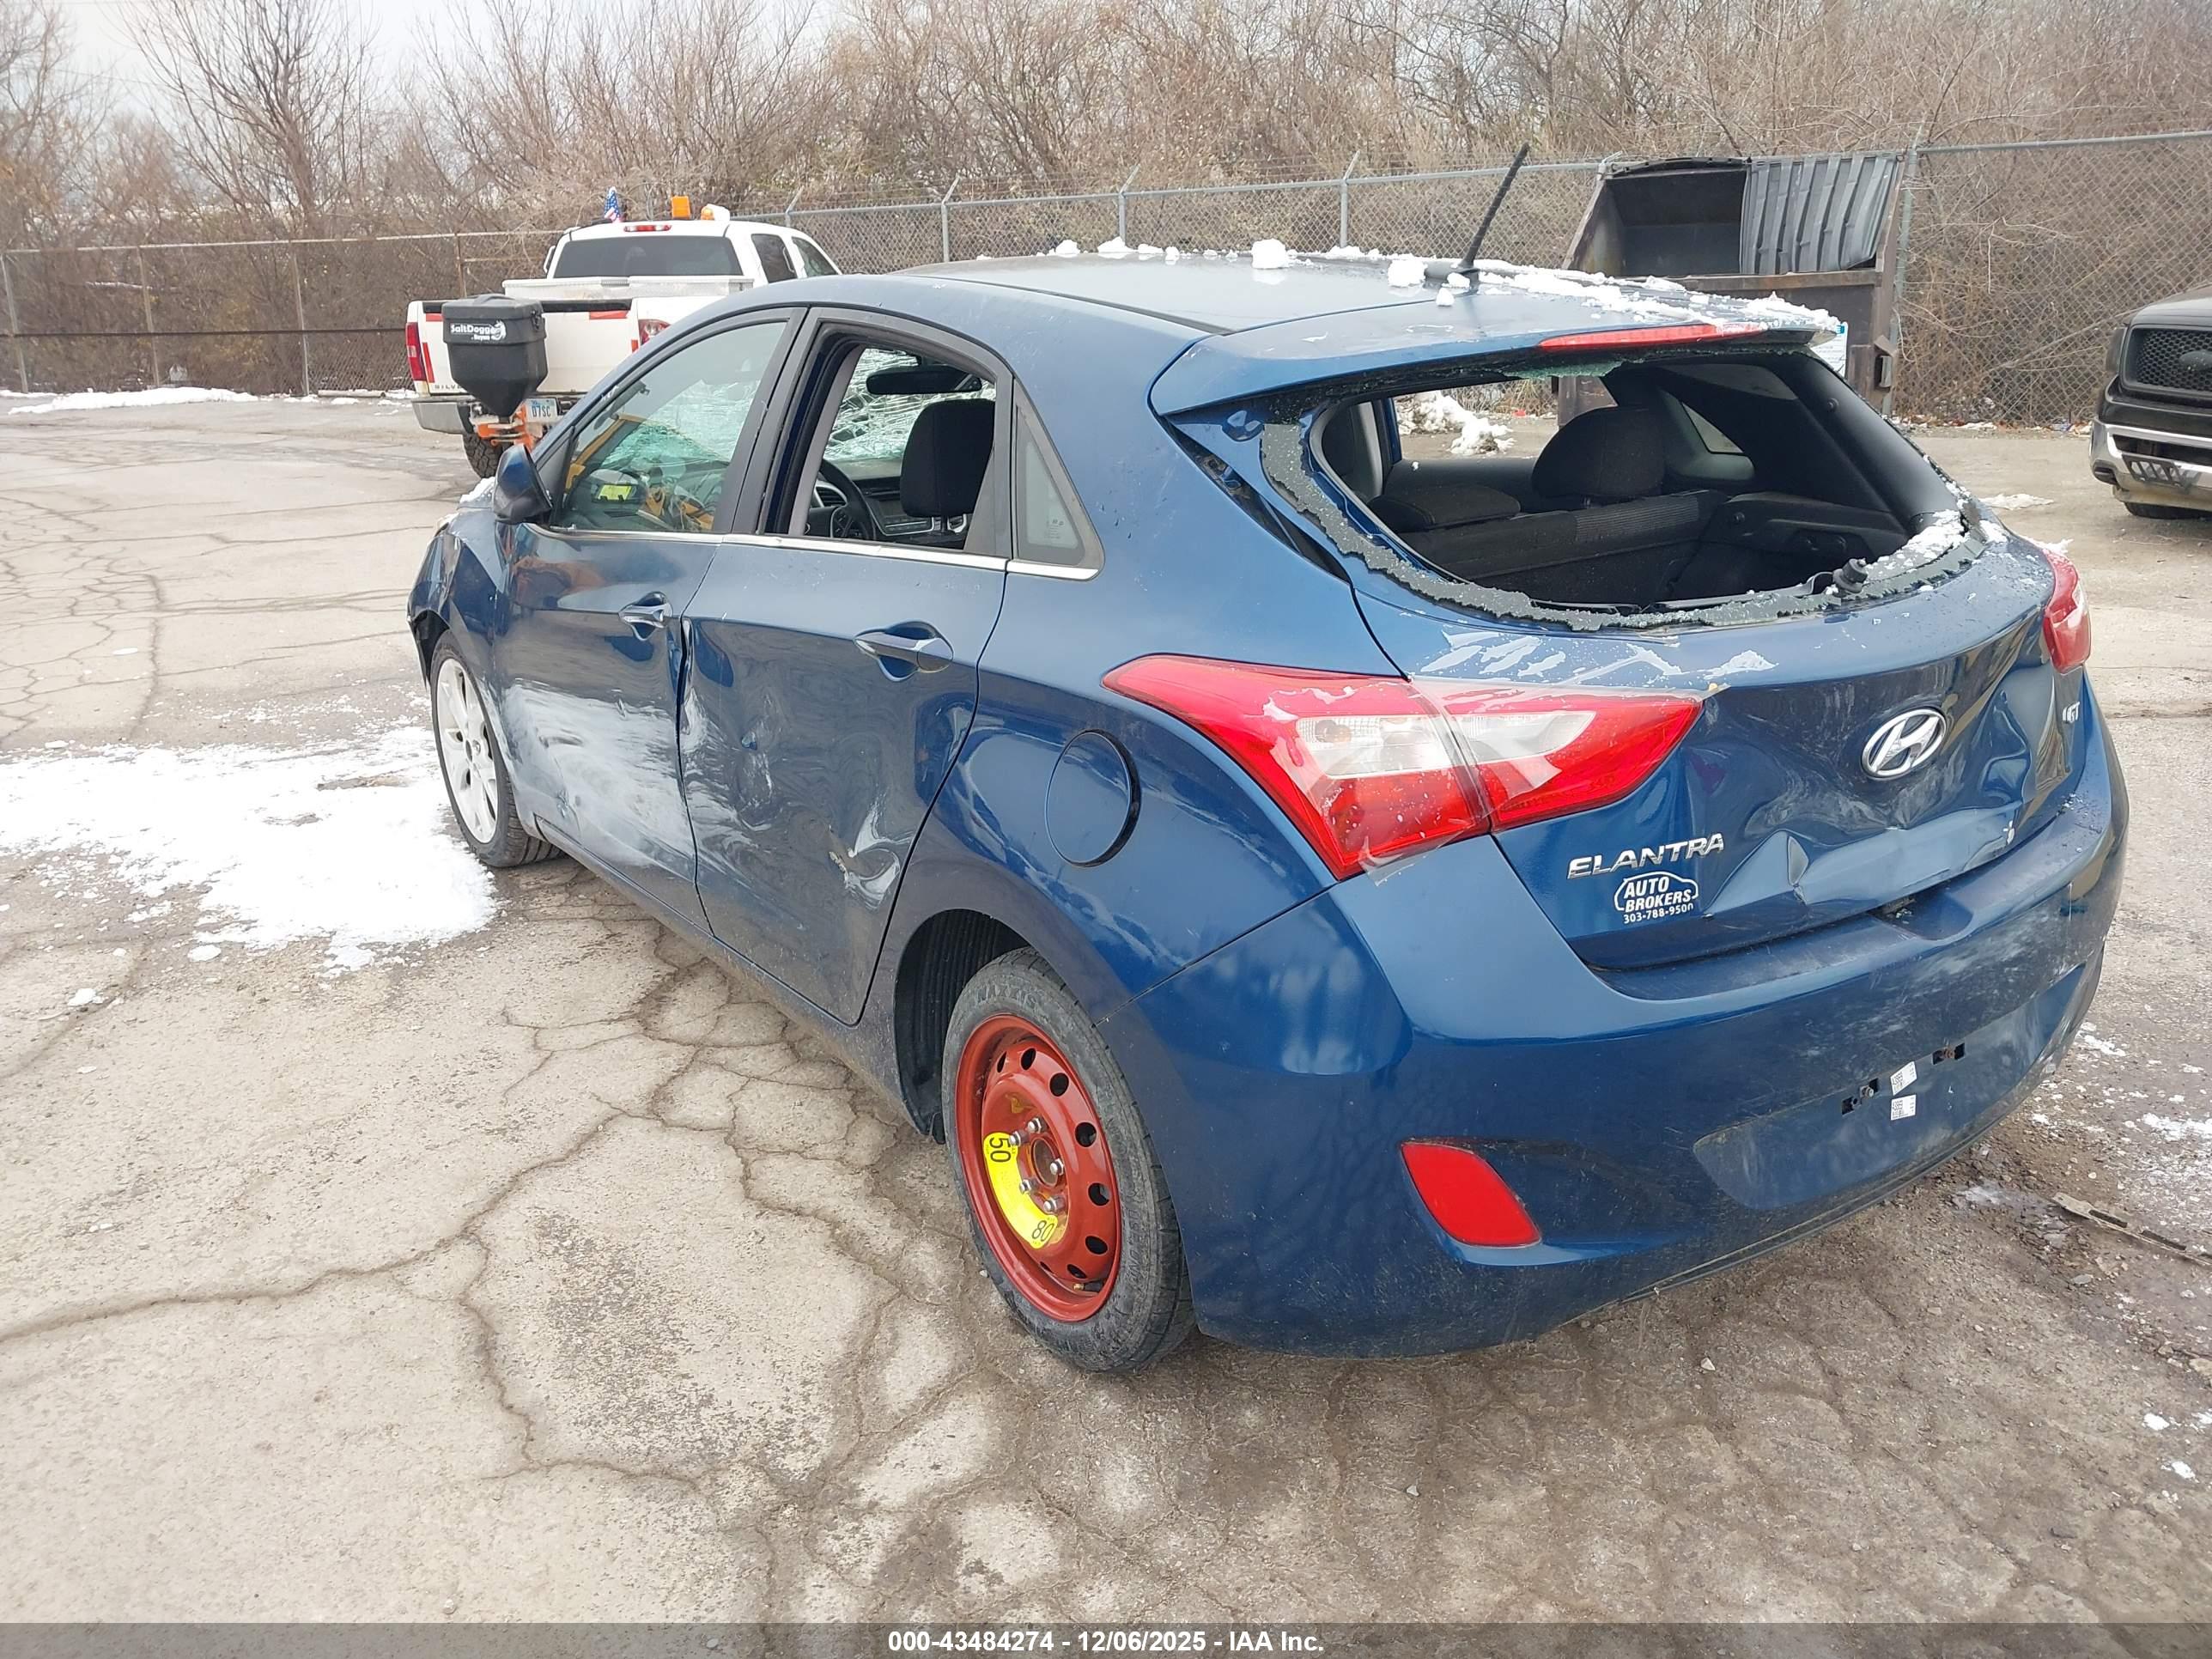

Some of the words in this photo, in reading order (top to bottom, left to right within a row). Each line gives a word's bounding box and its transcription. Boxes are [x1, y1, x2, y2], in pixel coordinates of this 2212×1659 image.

[1567, 833, 1724, 880] ELANTRA
[1624, 876, 1669, 898] AUTO
[1626, 890, 1692, 913] BROKERS
[1624, 902, 1694, 925] 303-788-9500
[989, 1137, 1012, 1163] 50
[1031, 1219, 1055, 1242] 80
